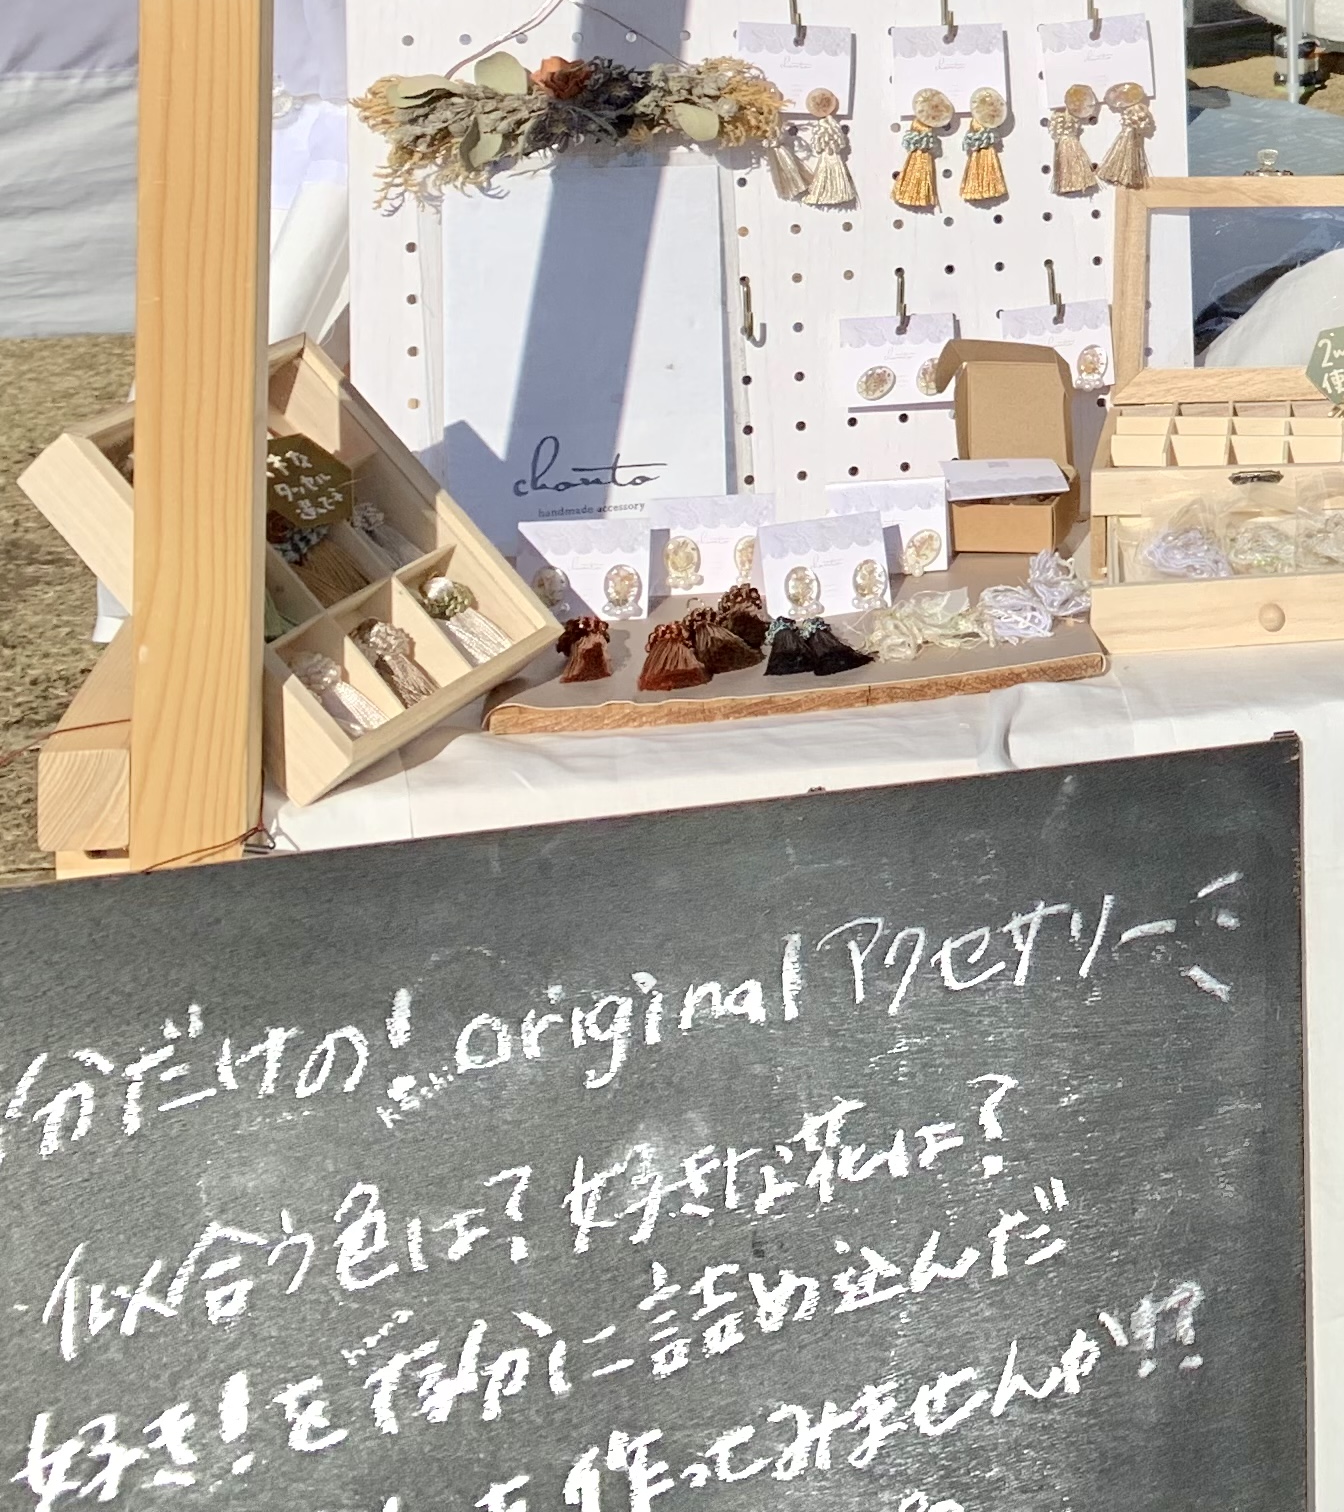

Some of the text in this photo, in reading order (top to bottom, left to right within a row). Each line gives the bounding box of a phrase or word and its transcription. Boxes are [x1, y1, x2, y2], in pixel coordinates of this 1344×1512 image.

[538, 502, 645, 518] handmade accessory
[0, 895, 1178, 1157] 分だけの! original アクセサリー
